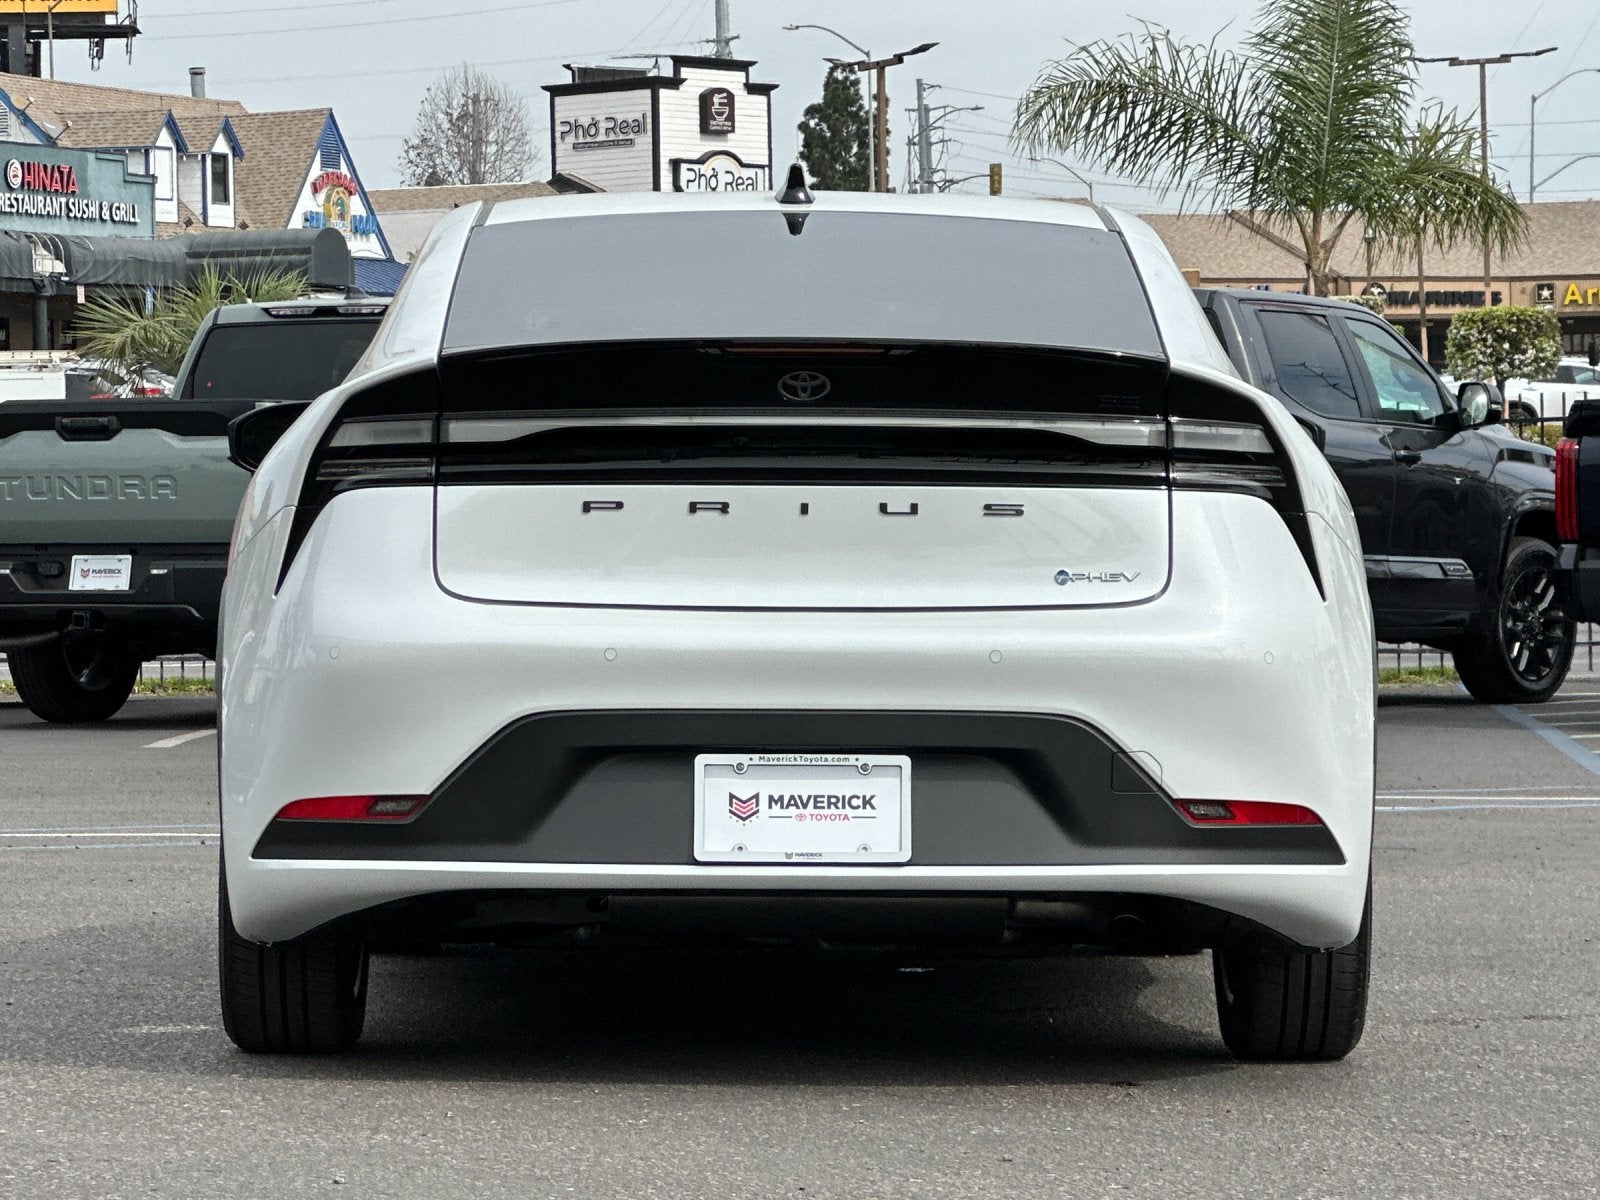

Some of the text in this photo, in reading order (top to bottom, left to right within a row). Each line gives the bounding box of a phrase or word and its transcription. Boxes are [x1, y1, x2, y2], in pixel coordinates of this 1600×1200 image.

[604, 112, 649, 138] Real
[22, 161, 78, 194] HINATA
[724, 170, 758, 192] Real
[0, 193, 140, 223] RESTAURANT SUSHI & GRILL
[0, 475, 178, 500] TUNDRA
[582, 501, 1024, 516] PRIUS
[767, 794, 876, 810] MAVERICK
